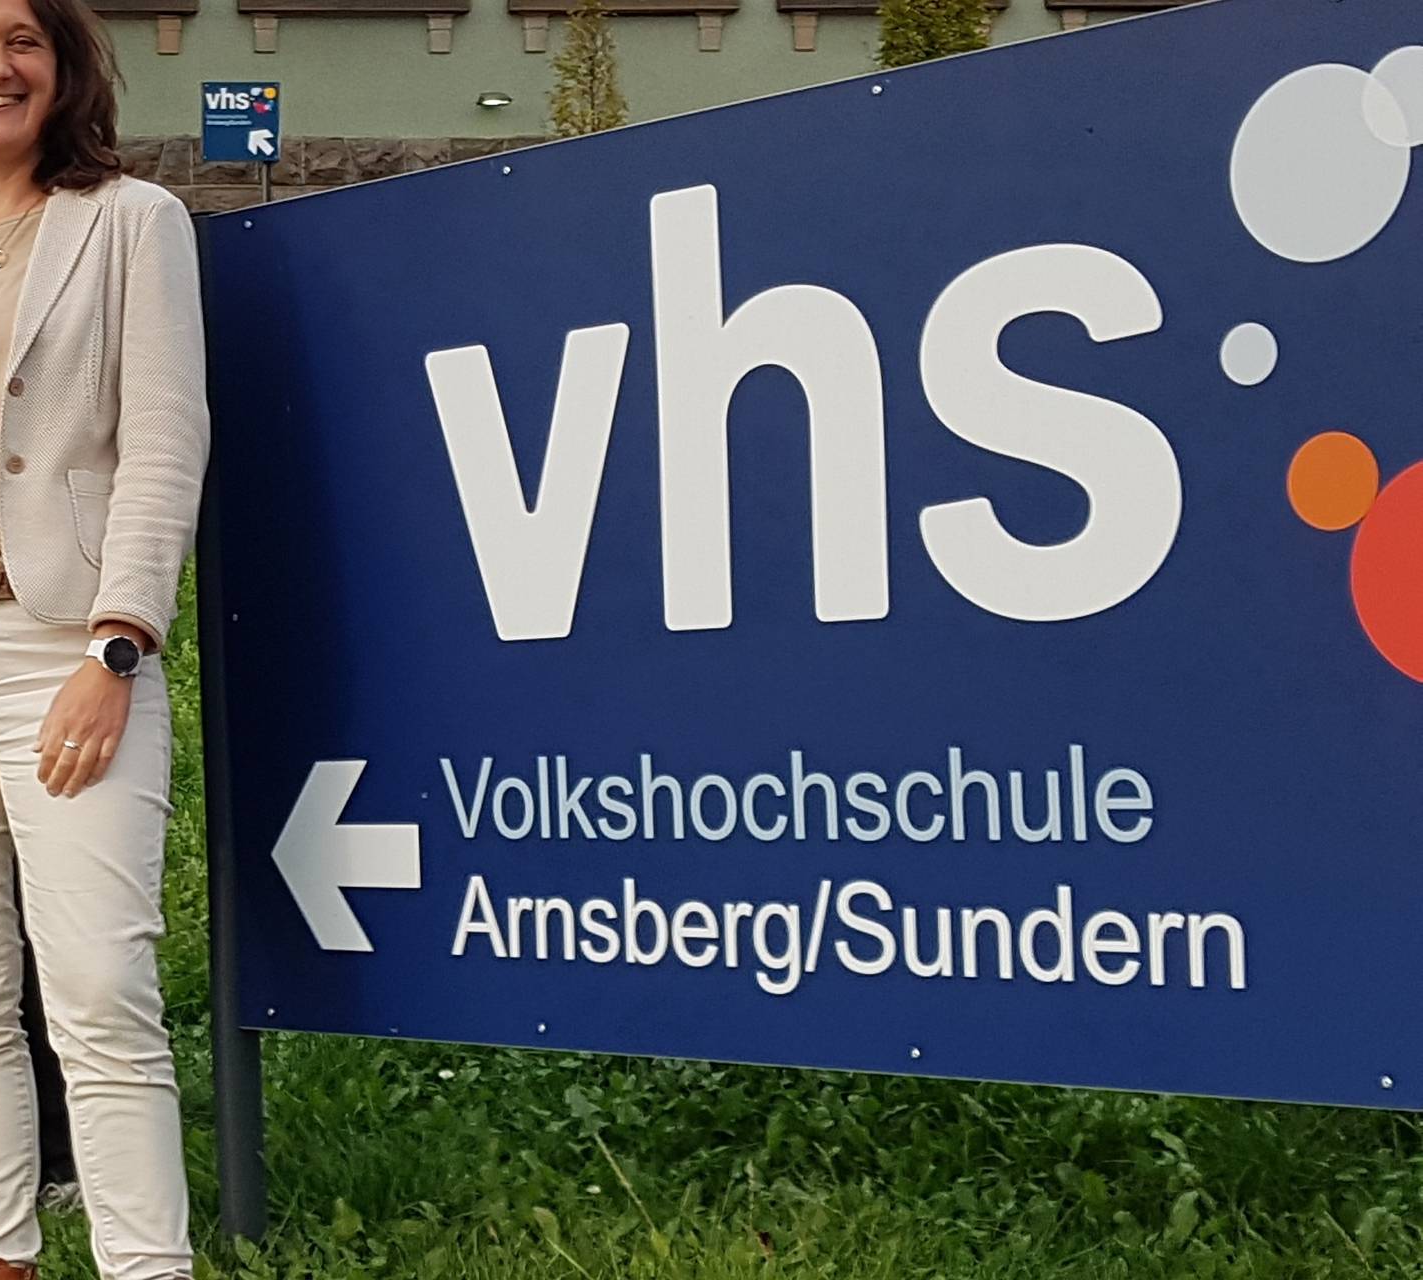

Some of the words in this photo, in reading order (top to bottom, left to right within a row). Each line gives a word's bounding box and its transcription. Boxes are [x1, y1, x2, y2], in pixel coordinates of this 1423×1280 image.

[205, 88, 250, 110] vhs
[424, 183, 1183, 641] vhs
[439, 745, 1154, 843] Volkshochschule
[450, 875, 1247, 995] Arnsberg/Sundern
